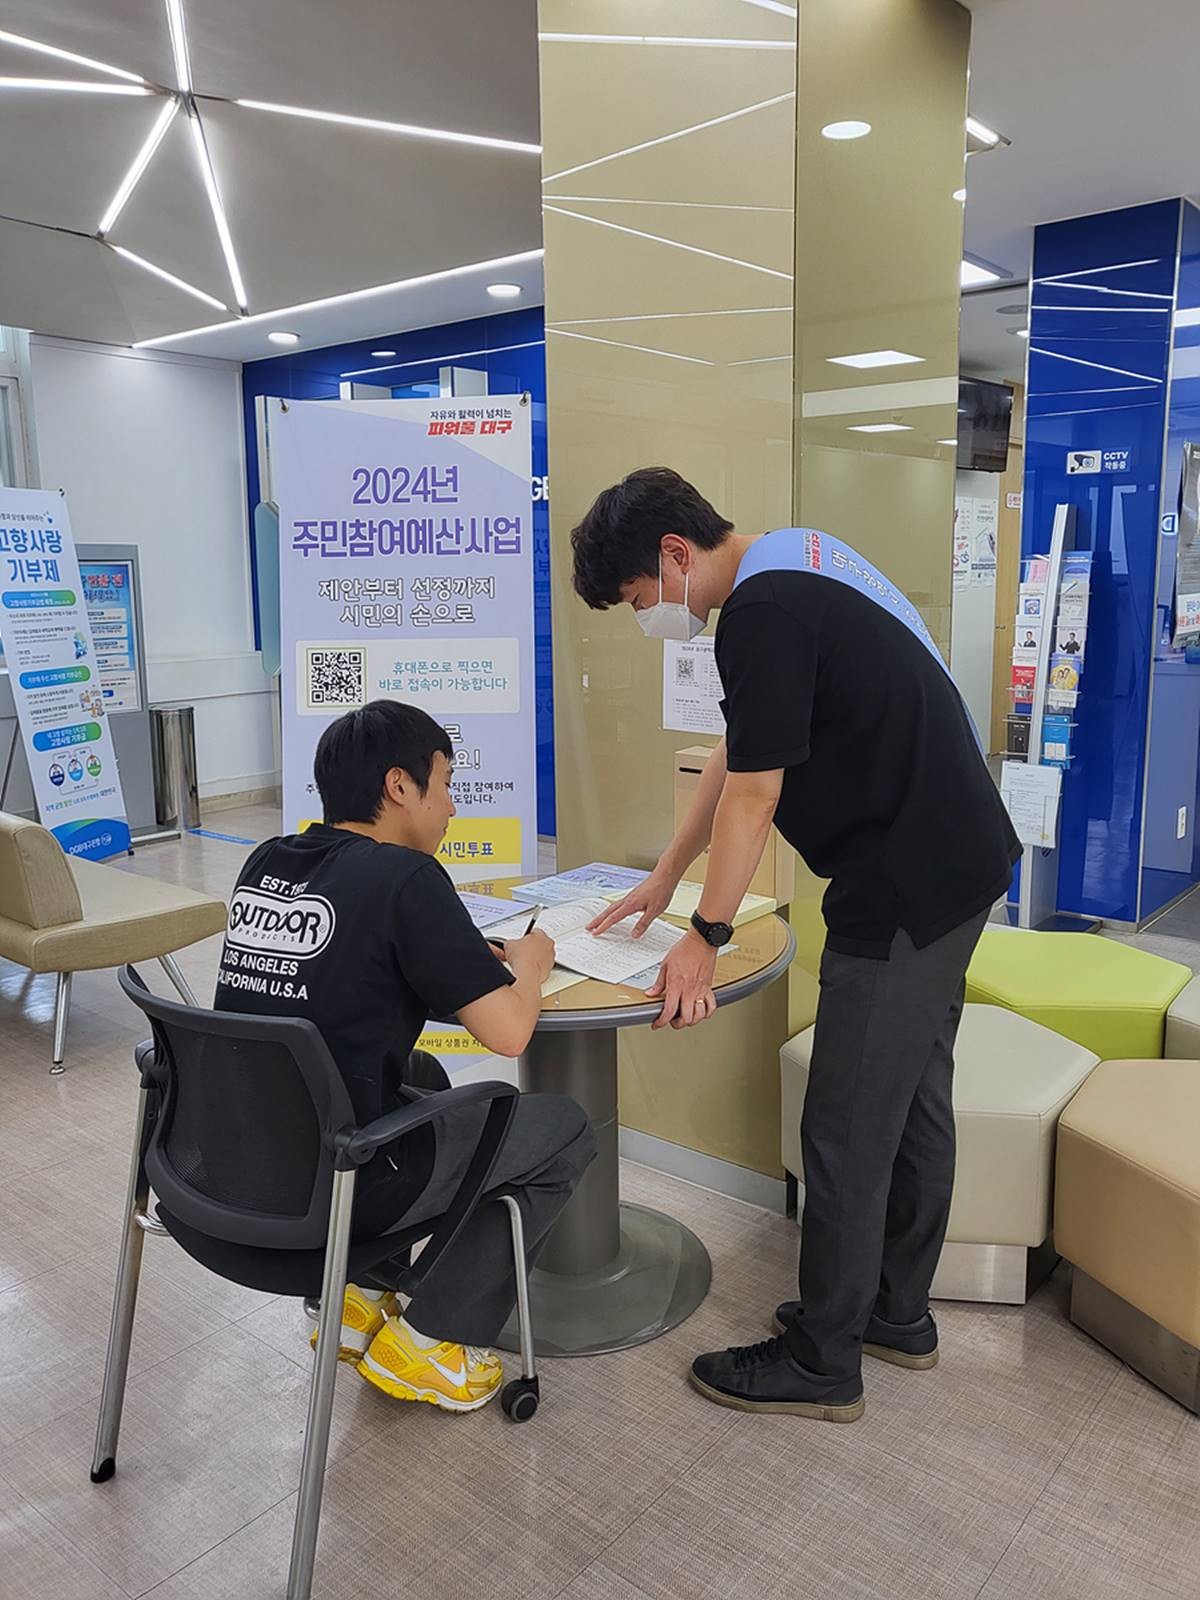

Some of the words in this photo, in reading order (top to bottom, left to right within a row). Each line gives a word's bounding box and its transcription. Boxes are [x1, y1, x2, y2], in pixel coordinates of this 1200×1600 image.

[430, 410, 456, 419] 자유와
[479, 420, 513, 435] 대구
[1103, 451, 1128, 460] CCTV
[352, 465, 458, 504] 2024년
[7, 559, 60, 583] 기부제
[319, 579, 403, 602] 제안부터
[411, 577, 495, 601] 선정까지
[340, 604, 402, 626] 시민의
[409, 604, 475, 626] 손으로
[393, 662, 452, 675] 휴대폰으로
[457, 660, 493, 674] 찍으면
[379, 678, 403, 691] 바로
[407, 677, 443, 691] 접속이
[448, 677, 508, 691] 가능합니다
[451, 782, 471, 793] 직접
[474, 781, 514, 793] 참여하여
[450, 794, 497, 804] 도입니다.
[440, 842, 493, 858] 시민투표
[230, 901, 321, 945] OUTDOOR
[224, 949, 239, 966] LOS
[239, 953, 299, 975] ANGELES
[269, 980, 308, 1000] U.S.A
[446, 1038, 469, 1048] 상품권
